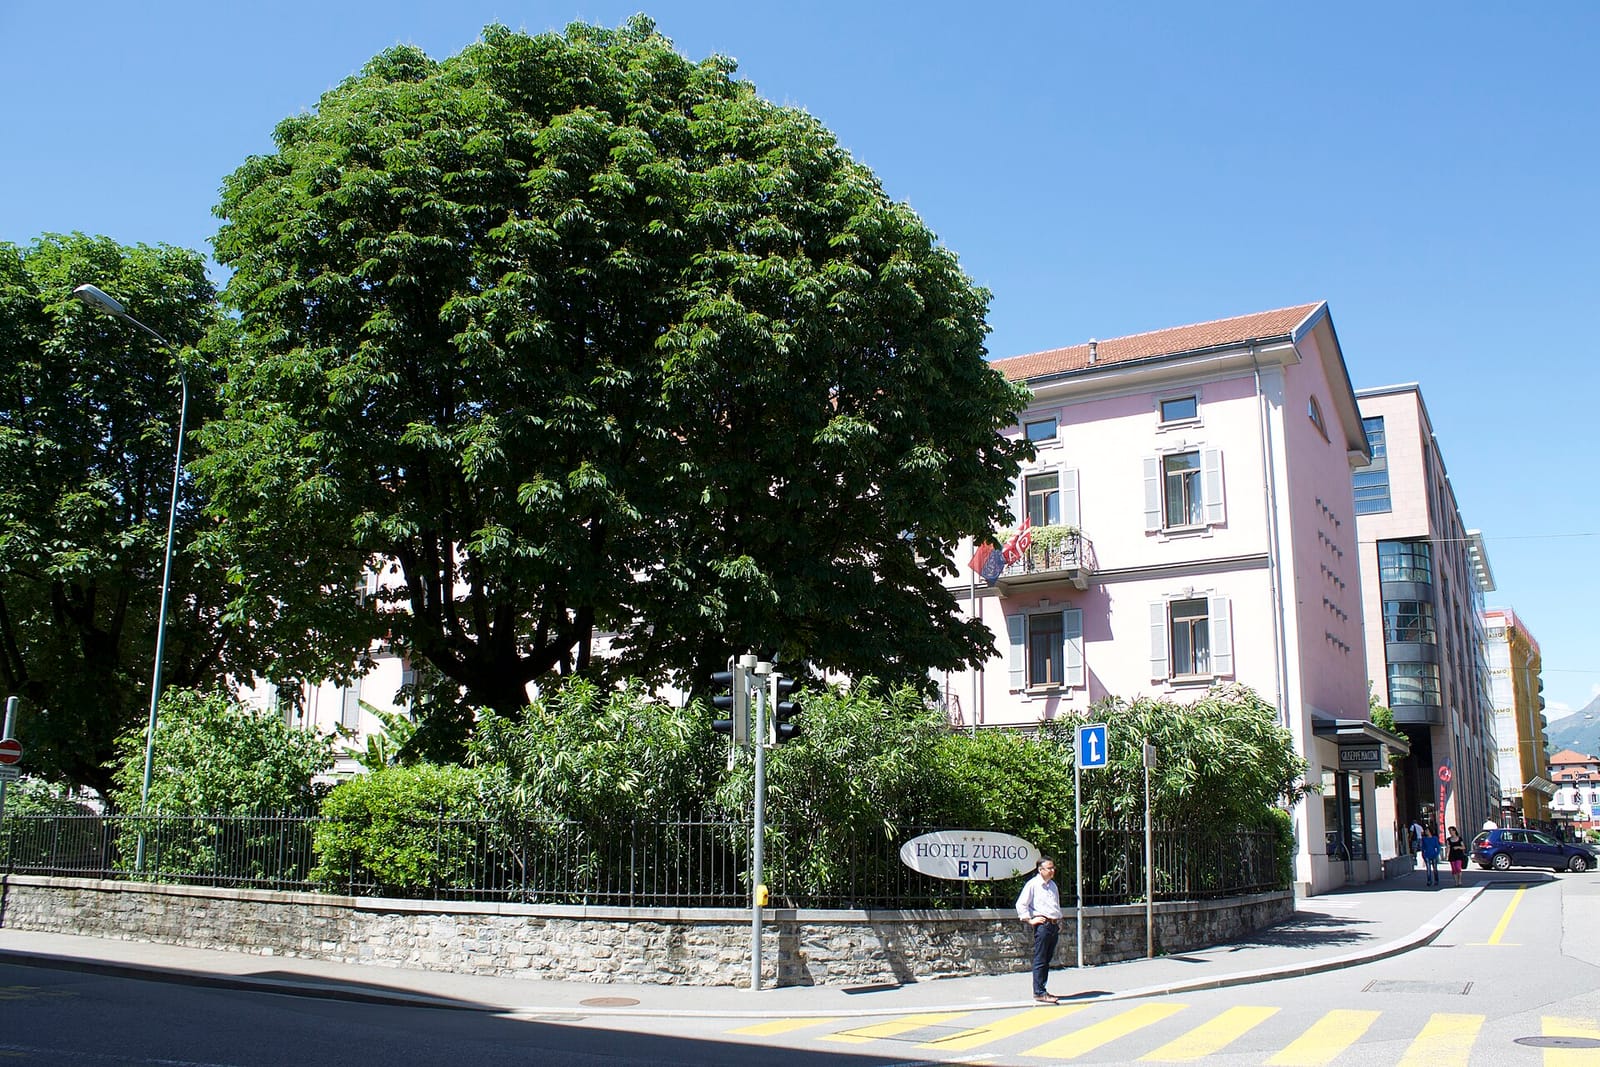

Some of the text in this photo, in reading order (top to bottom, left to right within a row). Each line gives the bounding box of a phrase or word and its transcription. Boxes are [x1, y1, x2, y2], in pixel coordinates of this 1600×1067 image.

[916, 843, 1029, 860] HOTEL ZURIGO
[960, 863, 968, 873] P
